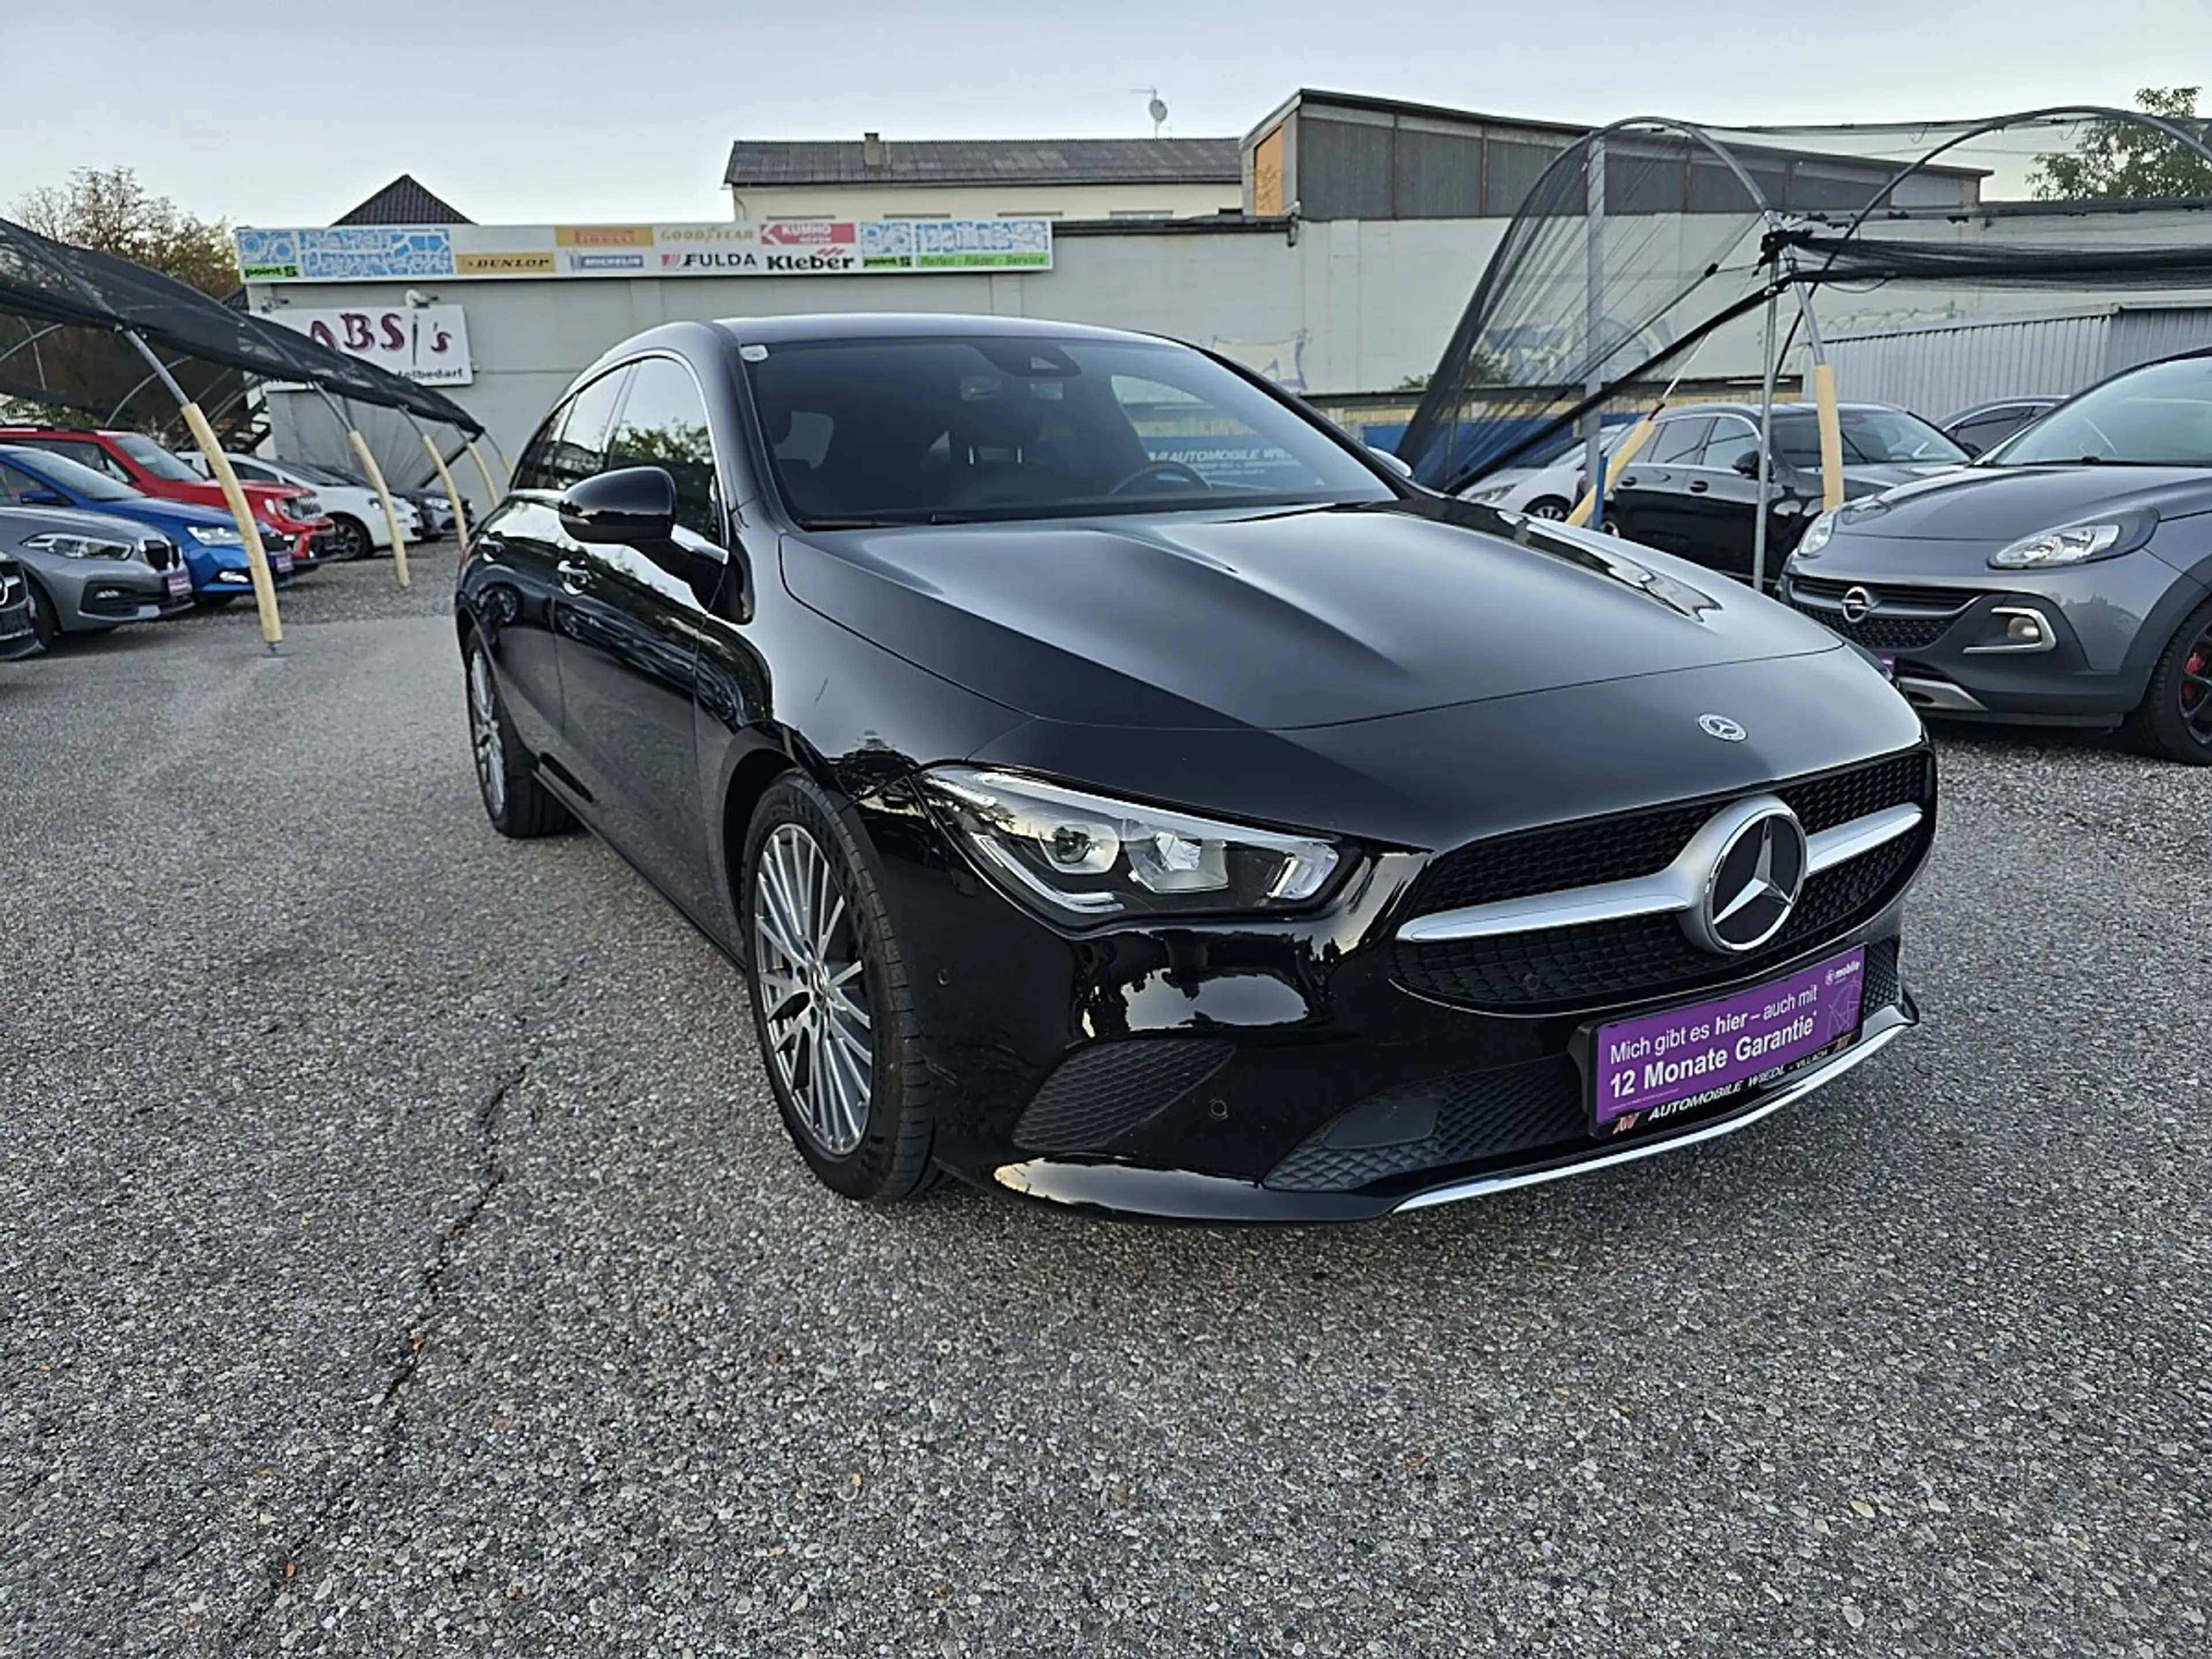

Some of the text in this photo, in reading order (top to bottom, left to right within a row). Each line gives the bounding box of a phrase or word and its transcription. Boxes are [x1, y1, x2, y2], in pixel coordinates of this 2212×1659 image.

[782, 223, 832, 236] KUMHO
[476, 258, 550, 268] DUNLOP
[585, 257, 641, 266] MICHELIN
[683, 253, 757, 267] FULDA
[767, 255, 855, 270] Kleber
[1006, 253, 1046, 266] Service
[1611, 1037, 1650, 1065] Mich
[1654, 1027, 1687, 1056] gibt
[1690, 1024, 1710, 1042] es
[1715, 1013, 1748, 1035] hier
[1763, 993, 1795, 1020] auch
[1798, 984, 1817, 1007] mit
[1610, 1069, 1635, 1099] 12
[1644, 1047, 1728, 1089] Monate
[1648, 1080, 1744, 1122] AUTOMOBILE
